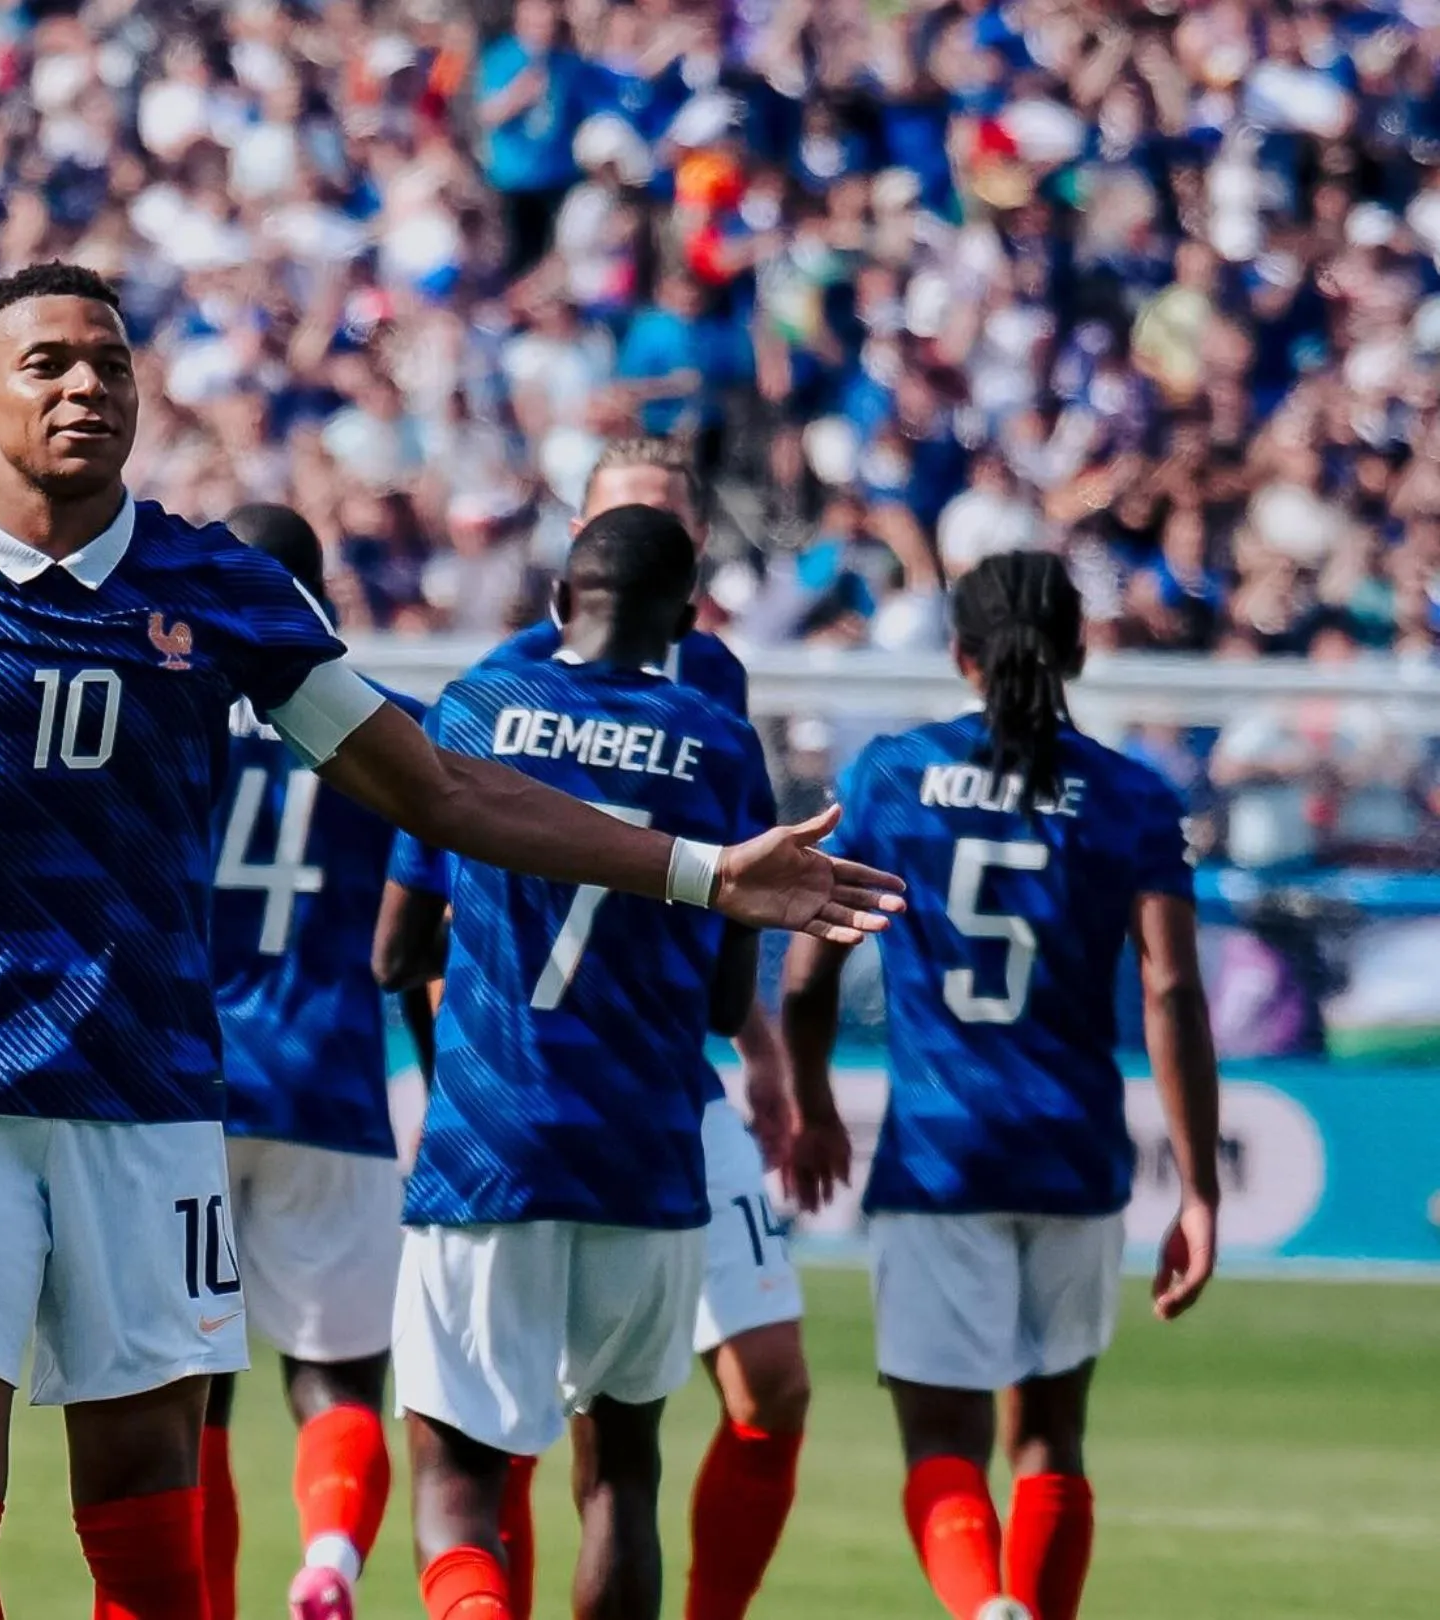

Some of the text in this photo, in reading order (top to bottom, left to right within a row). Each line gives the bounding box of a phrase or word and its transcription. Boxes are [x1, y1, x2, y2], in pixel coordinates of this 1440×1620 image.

[32, 668, 122, 770] 10
[493, 705, 704, 782] DEMBELE
[920, 764, 1086, 817] KOUE
[213, 766, 324, 956] 4
[942, 837, 1048, 1025] 5
[175, 1195, 241, 1299] 10
